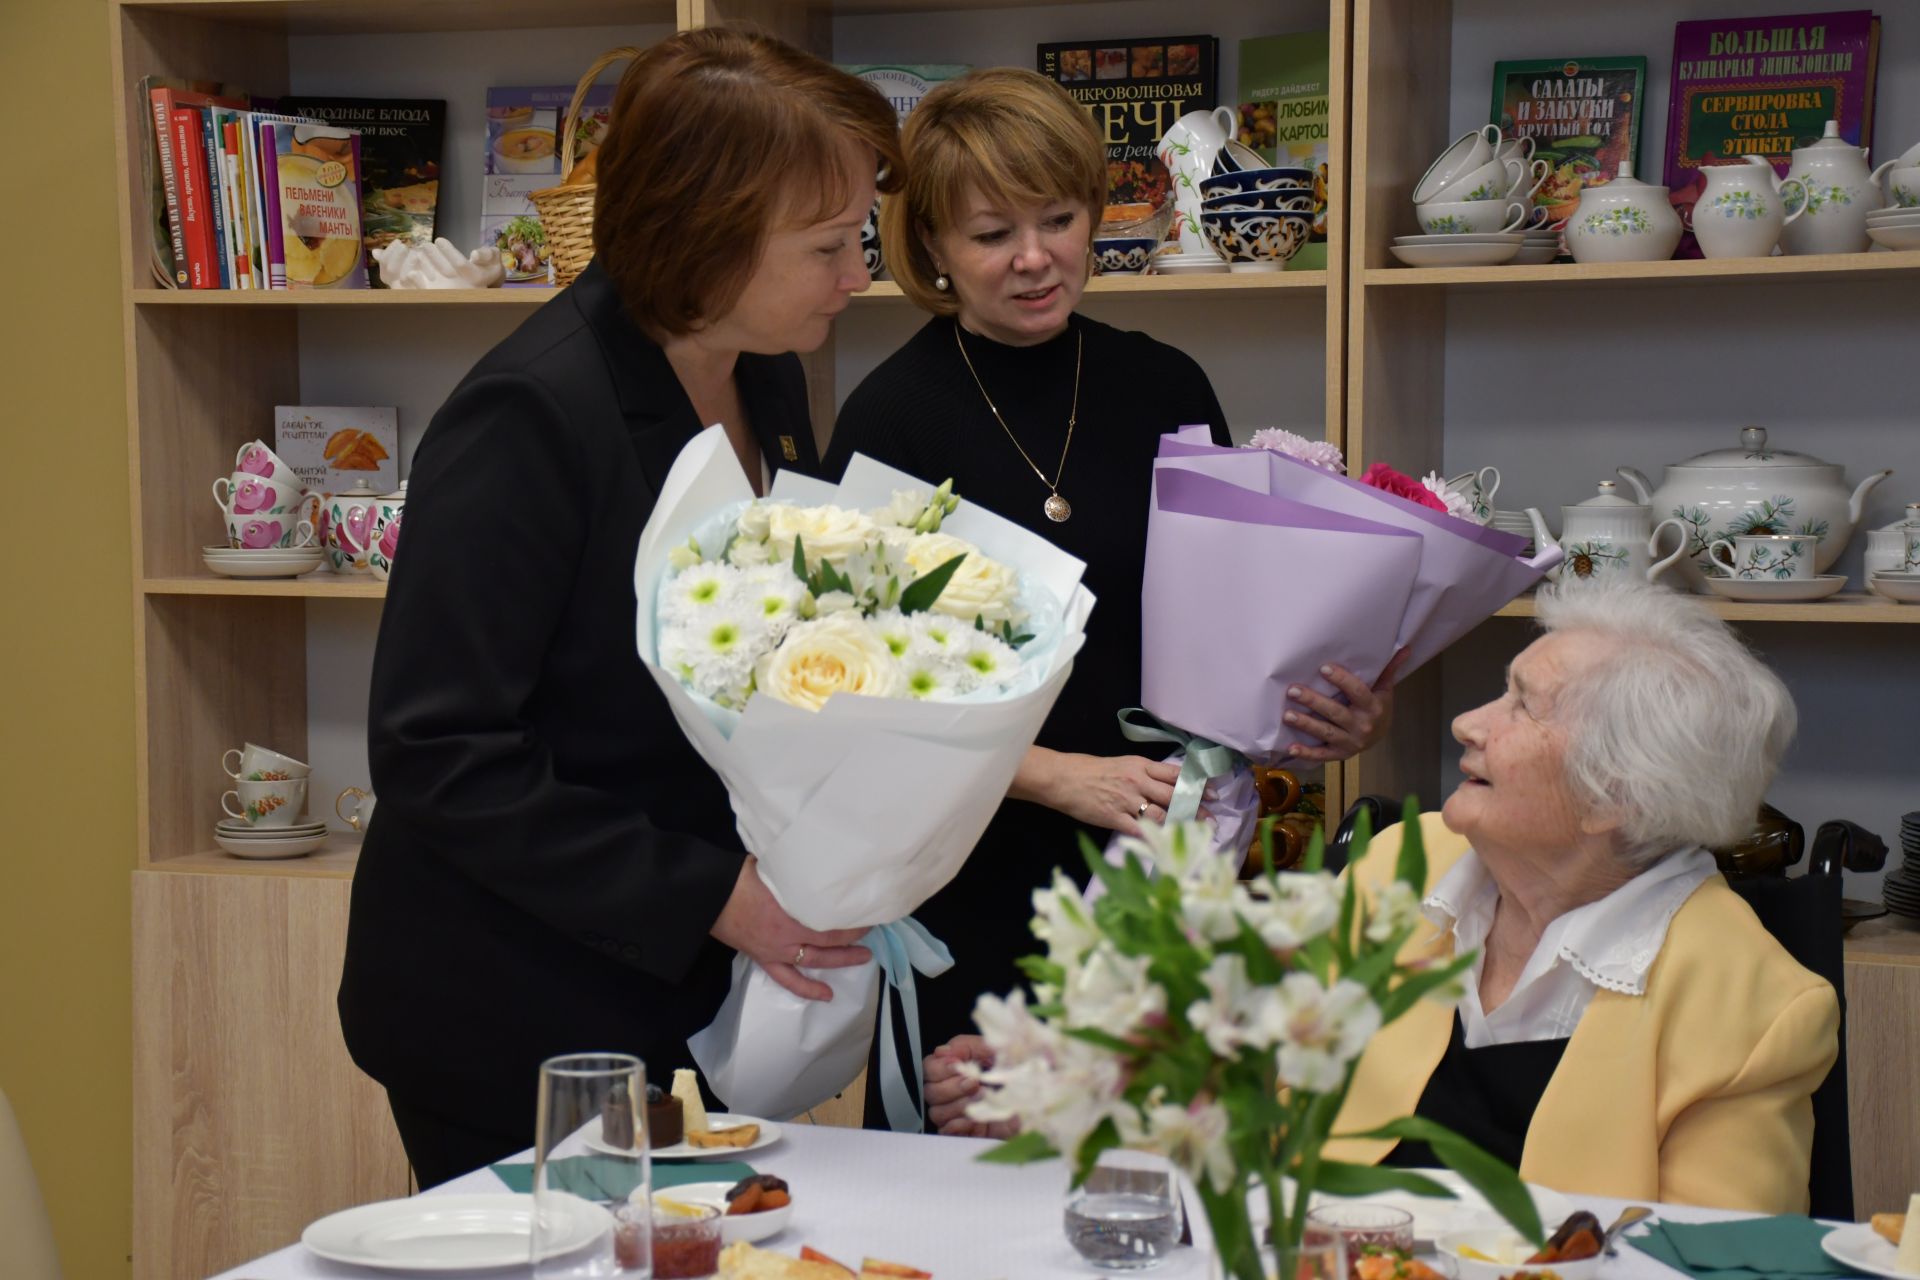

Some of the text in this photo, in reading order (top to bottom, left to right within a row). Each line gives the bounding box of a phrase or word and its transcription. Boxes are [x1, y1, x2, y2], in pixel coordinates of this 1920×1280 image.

[1709, 26, 1826, 56] БОЛЬШАЯ
[1679, 52, 1853, 80] КУЛИНАРНАЯ ЭНЦИКЛОПЕДИЯ
[1280, 82, 1320, 96] ДАЙДЖЕСТ
[1532, 78, 1604, 98] САЛАТЫ
[1280, 100, 1329, 119] ЛЮБИМ
[1517, 99, 1615, 121] И ЗАКУСКИ
[1701, 91, 1823, 113] СЕРВИРОВКА
[297, 107, 430, 121] ХОЛОДНЫЕ БЛЮДА
[1730, 112, 1789, 131] СТОЛА
[379, 127, 408, 137] ВКУС
[1280, 124, 1328, 142] КАРТОШ
[1518, 121, 1611, 137] КРУГЛЫЙ ГОД
[1722, 135, 1795, 155] ЭТИКЕТ
[154, 103, 184, 261] БЛЮДА НА ПРАЗДНИЧНОМ СТОЛЕ
[286, 186, 334, 202] ПЕЛЬМЕНИ
[299, 203, 346, 220] ВАРЕНИКИ
[319, 222, 353, 236] МАНТЫ
